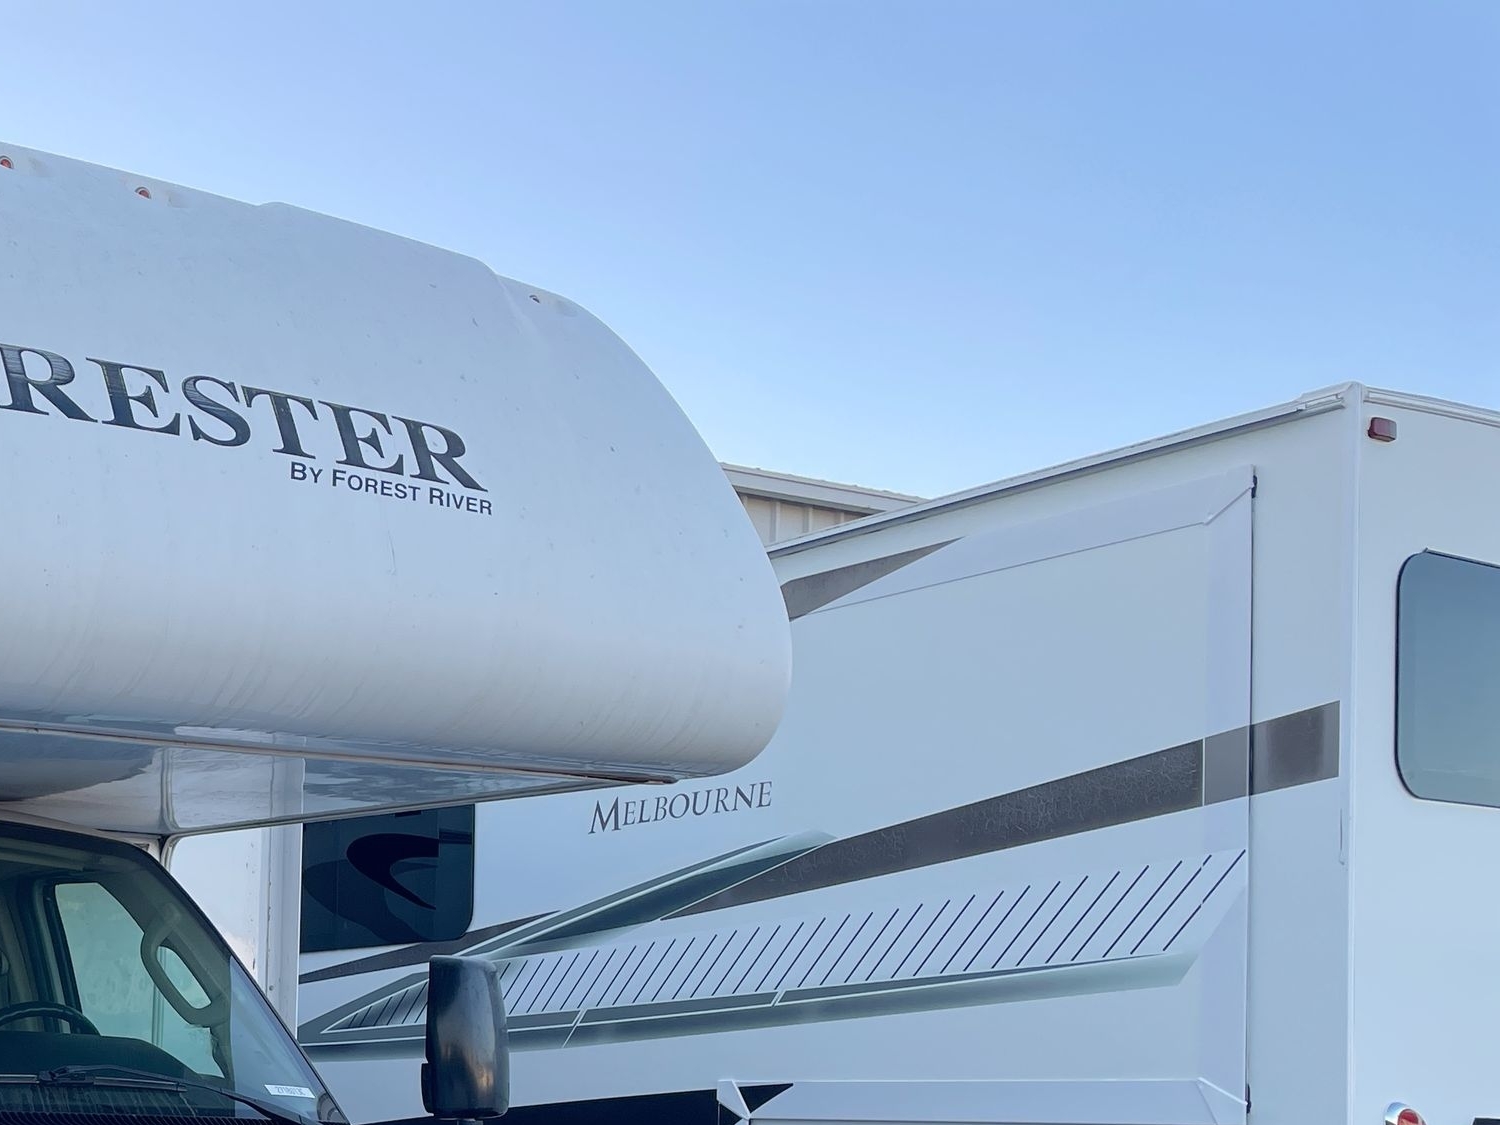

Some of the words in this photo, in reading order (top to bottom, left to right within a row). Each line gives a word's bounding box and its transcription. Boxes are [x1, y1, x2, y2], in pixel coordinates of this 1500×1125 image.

[290, 460, 323, 483] BY
[332, 468, 421, 502] FOREST
[429, 486, 493, 515] RIVER
[587, 780, 773, 835] MELBOURNE
